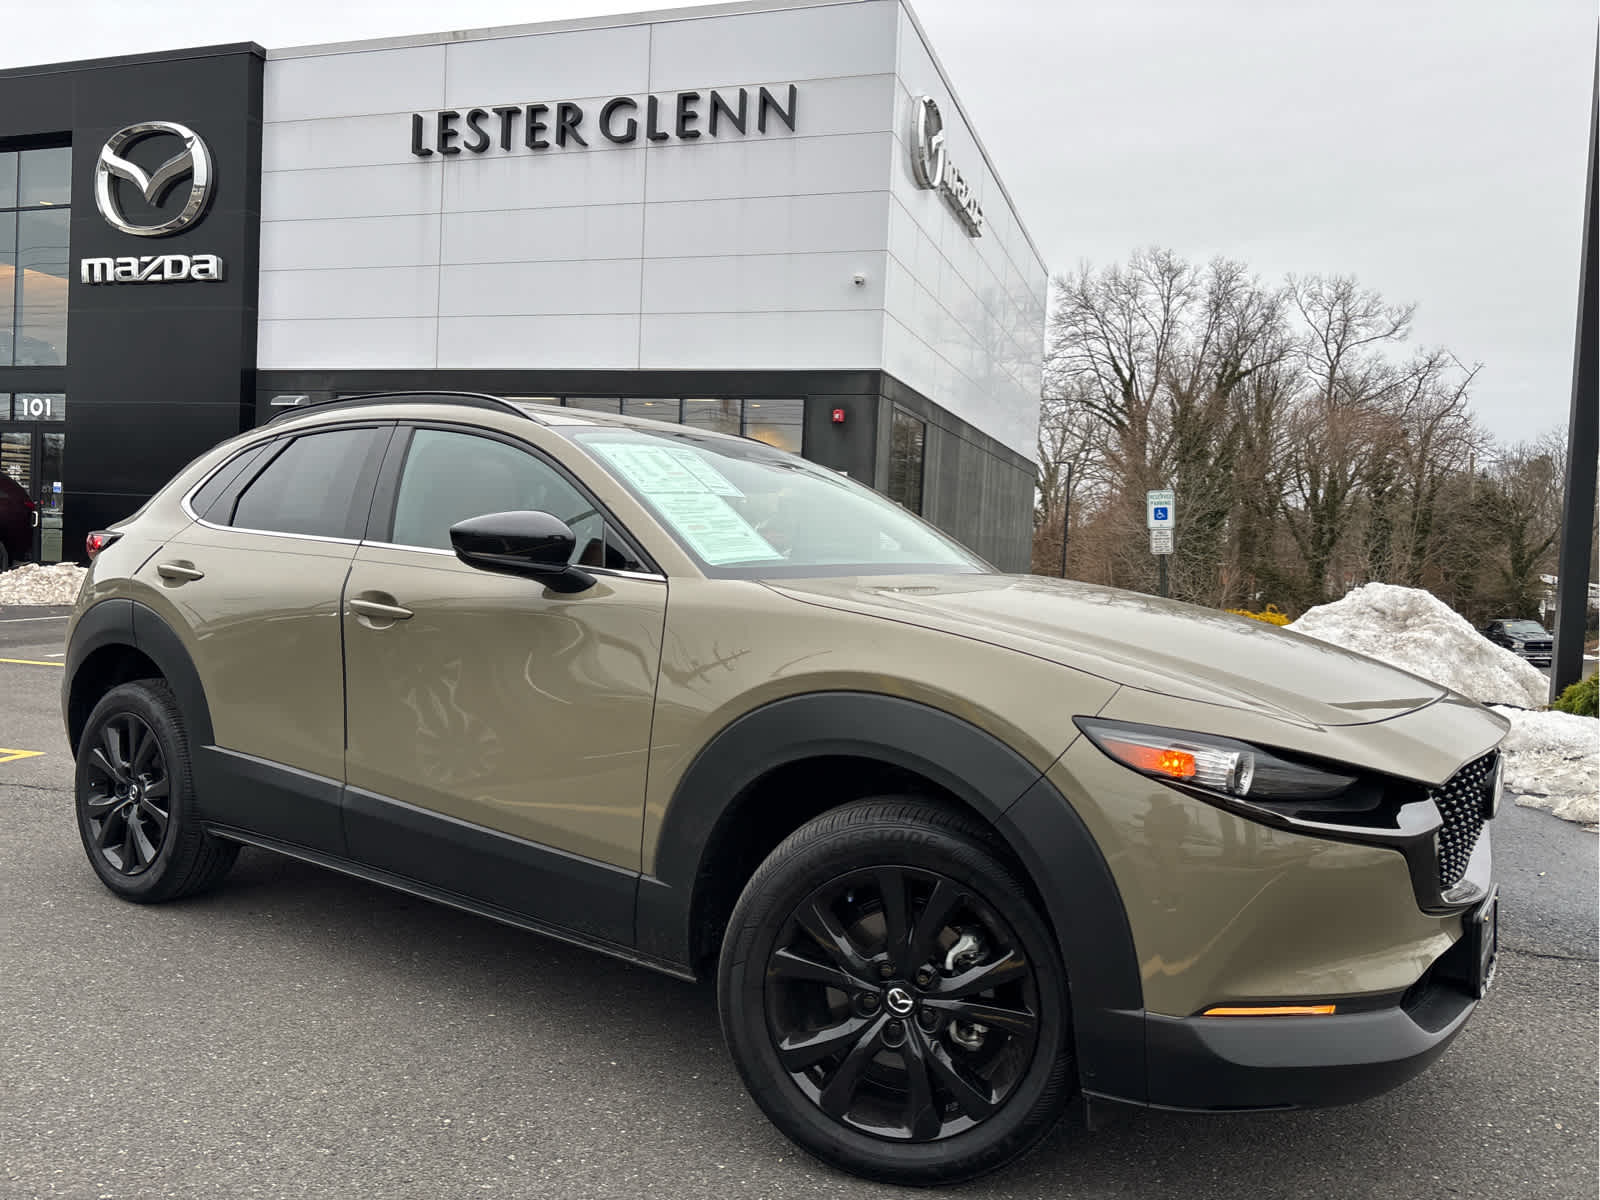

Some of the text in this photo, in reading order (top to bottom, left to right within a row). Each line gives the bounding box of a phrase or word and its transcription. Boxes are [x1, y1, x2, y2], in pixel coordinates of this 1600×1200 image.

[411, 83, 798, 157] LESTER GLENN
[22, 398, 51, 417] 101
